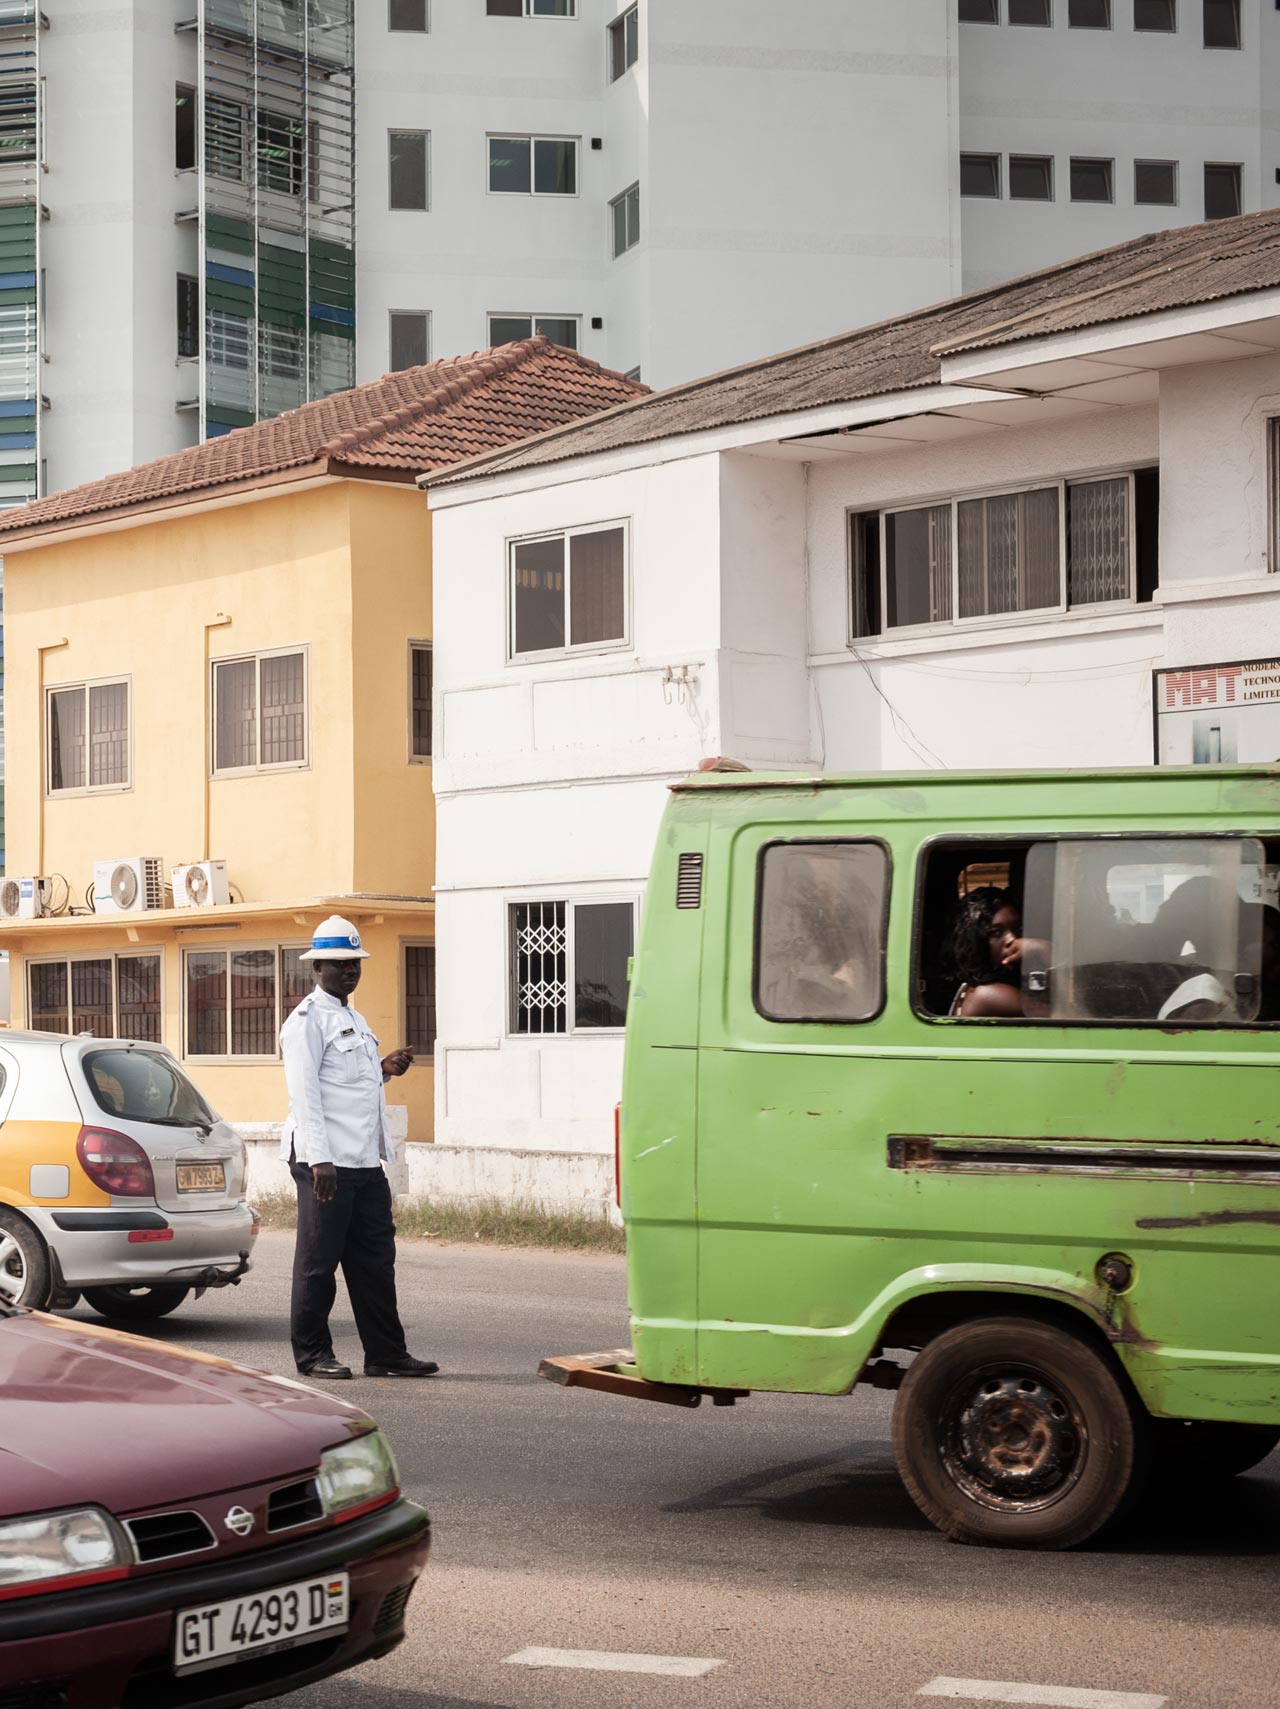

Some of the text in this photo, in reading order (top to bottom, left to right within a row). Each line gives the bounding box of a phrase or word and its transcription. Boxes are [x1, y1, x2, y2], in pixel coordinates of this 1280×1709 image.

[1166, 666, 1242, 706] MAT
[183, 1609, 221, 1657] GT
[231, 1590, 299, 1645] 4293
[308, 1583, 326, 1626] D
[328, 1602, 344, 1618] GH
